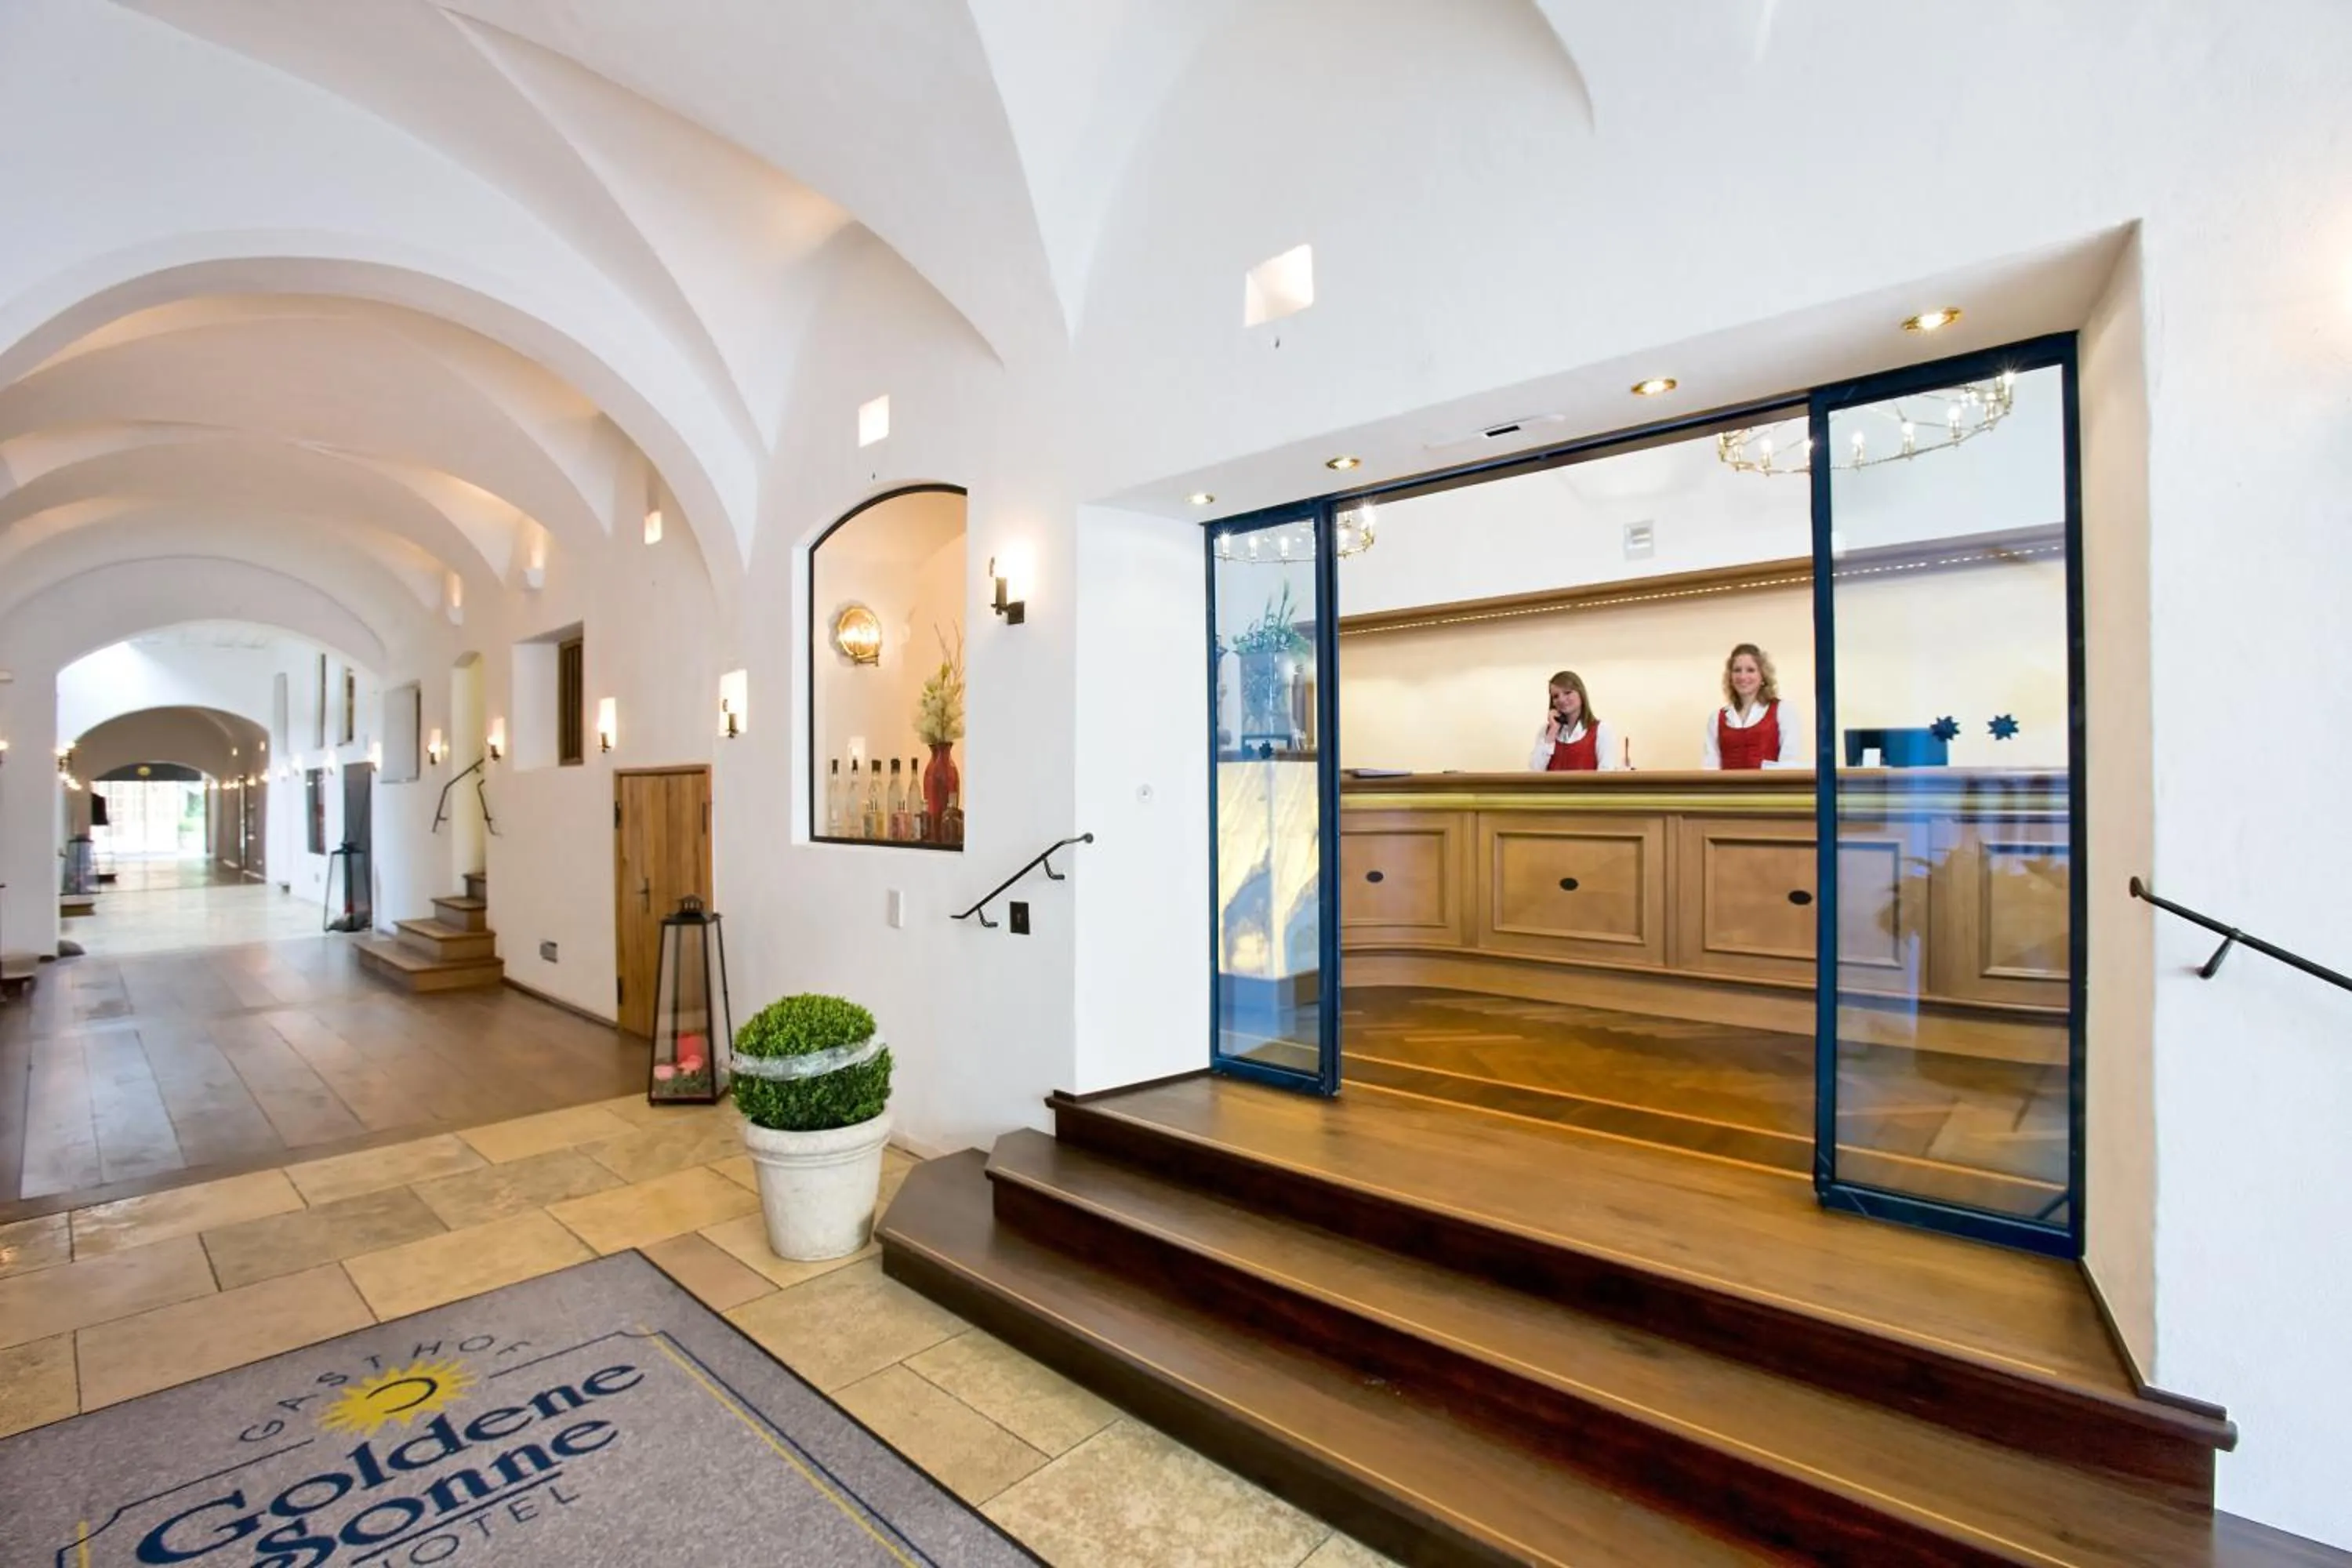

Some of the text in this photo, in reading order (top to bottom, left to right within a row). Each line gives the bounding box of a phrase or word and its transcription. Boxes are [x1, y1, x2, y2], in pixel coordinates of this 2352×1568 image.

[240, 1334, 532, 1443] GASTHOF
[136, 1365, 645, 1565] Goldene
[381, 1486, 581, 1568] OTEL
